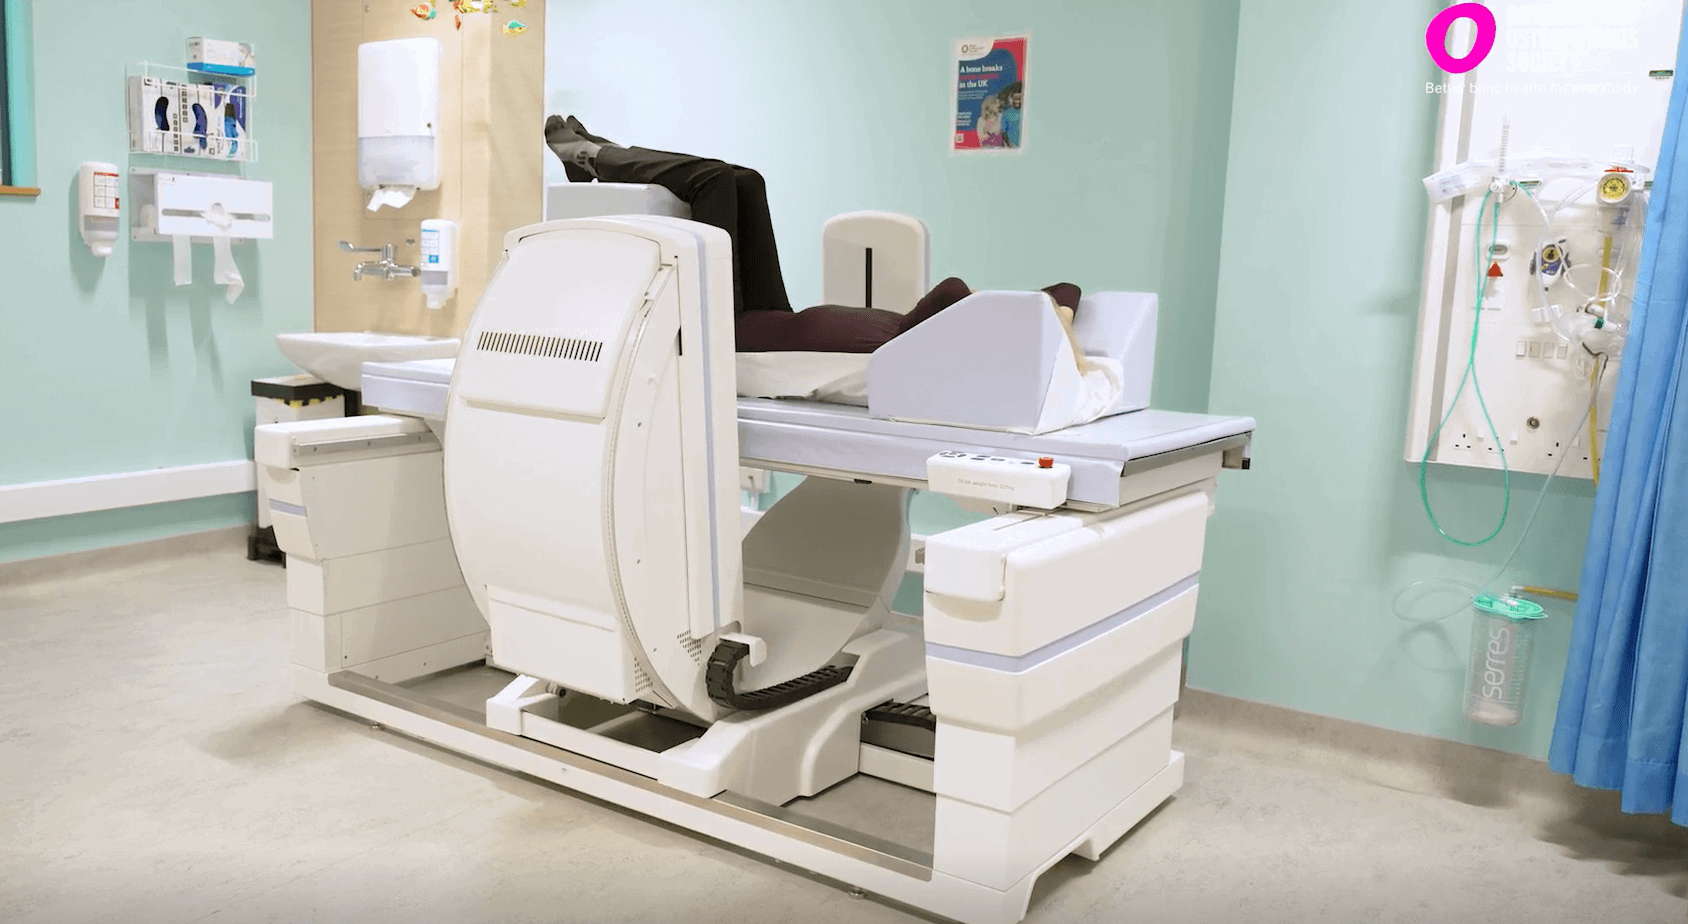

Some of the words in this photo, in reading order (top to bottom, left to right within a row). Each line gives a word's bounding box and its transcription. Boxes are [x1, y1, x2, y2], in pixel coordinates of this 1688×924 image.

[960, 65, 966, 73] A
[966, 65, 981, 73] bone
[982, 64, 1003, 72] breaks
[1482, 627, 1510, 700] serres
